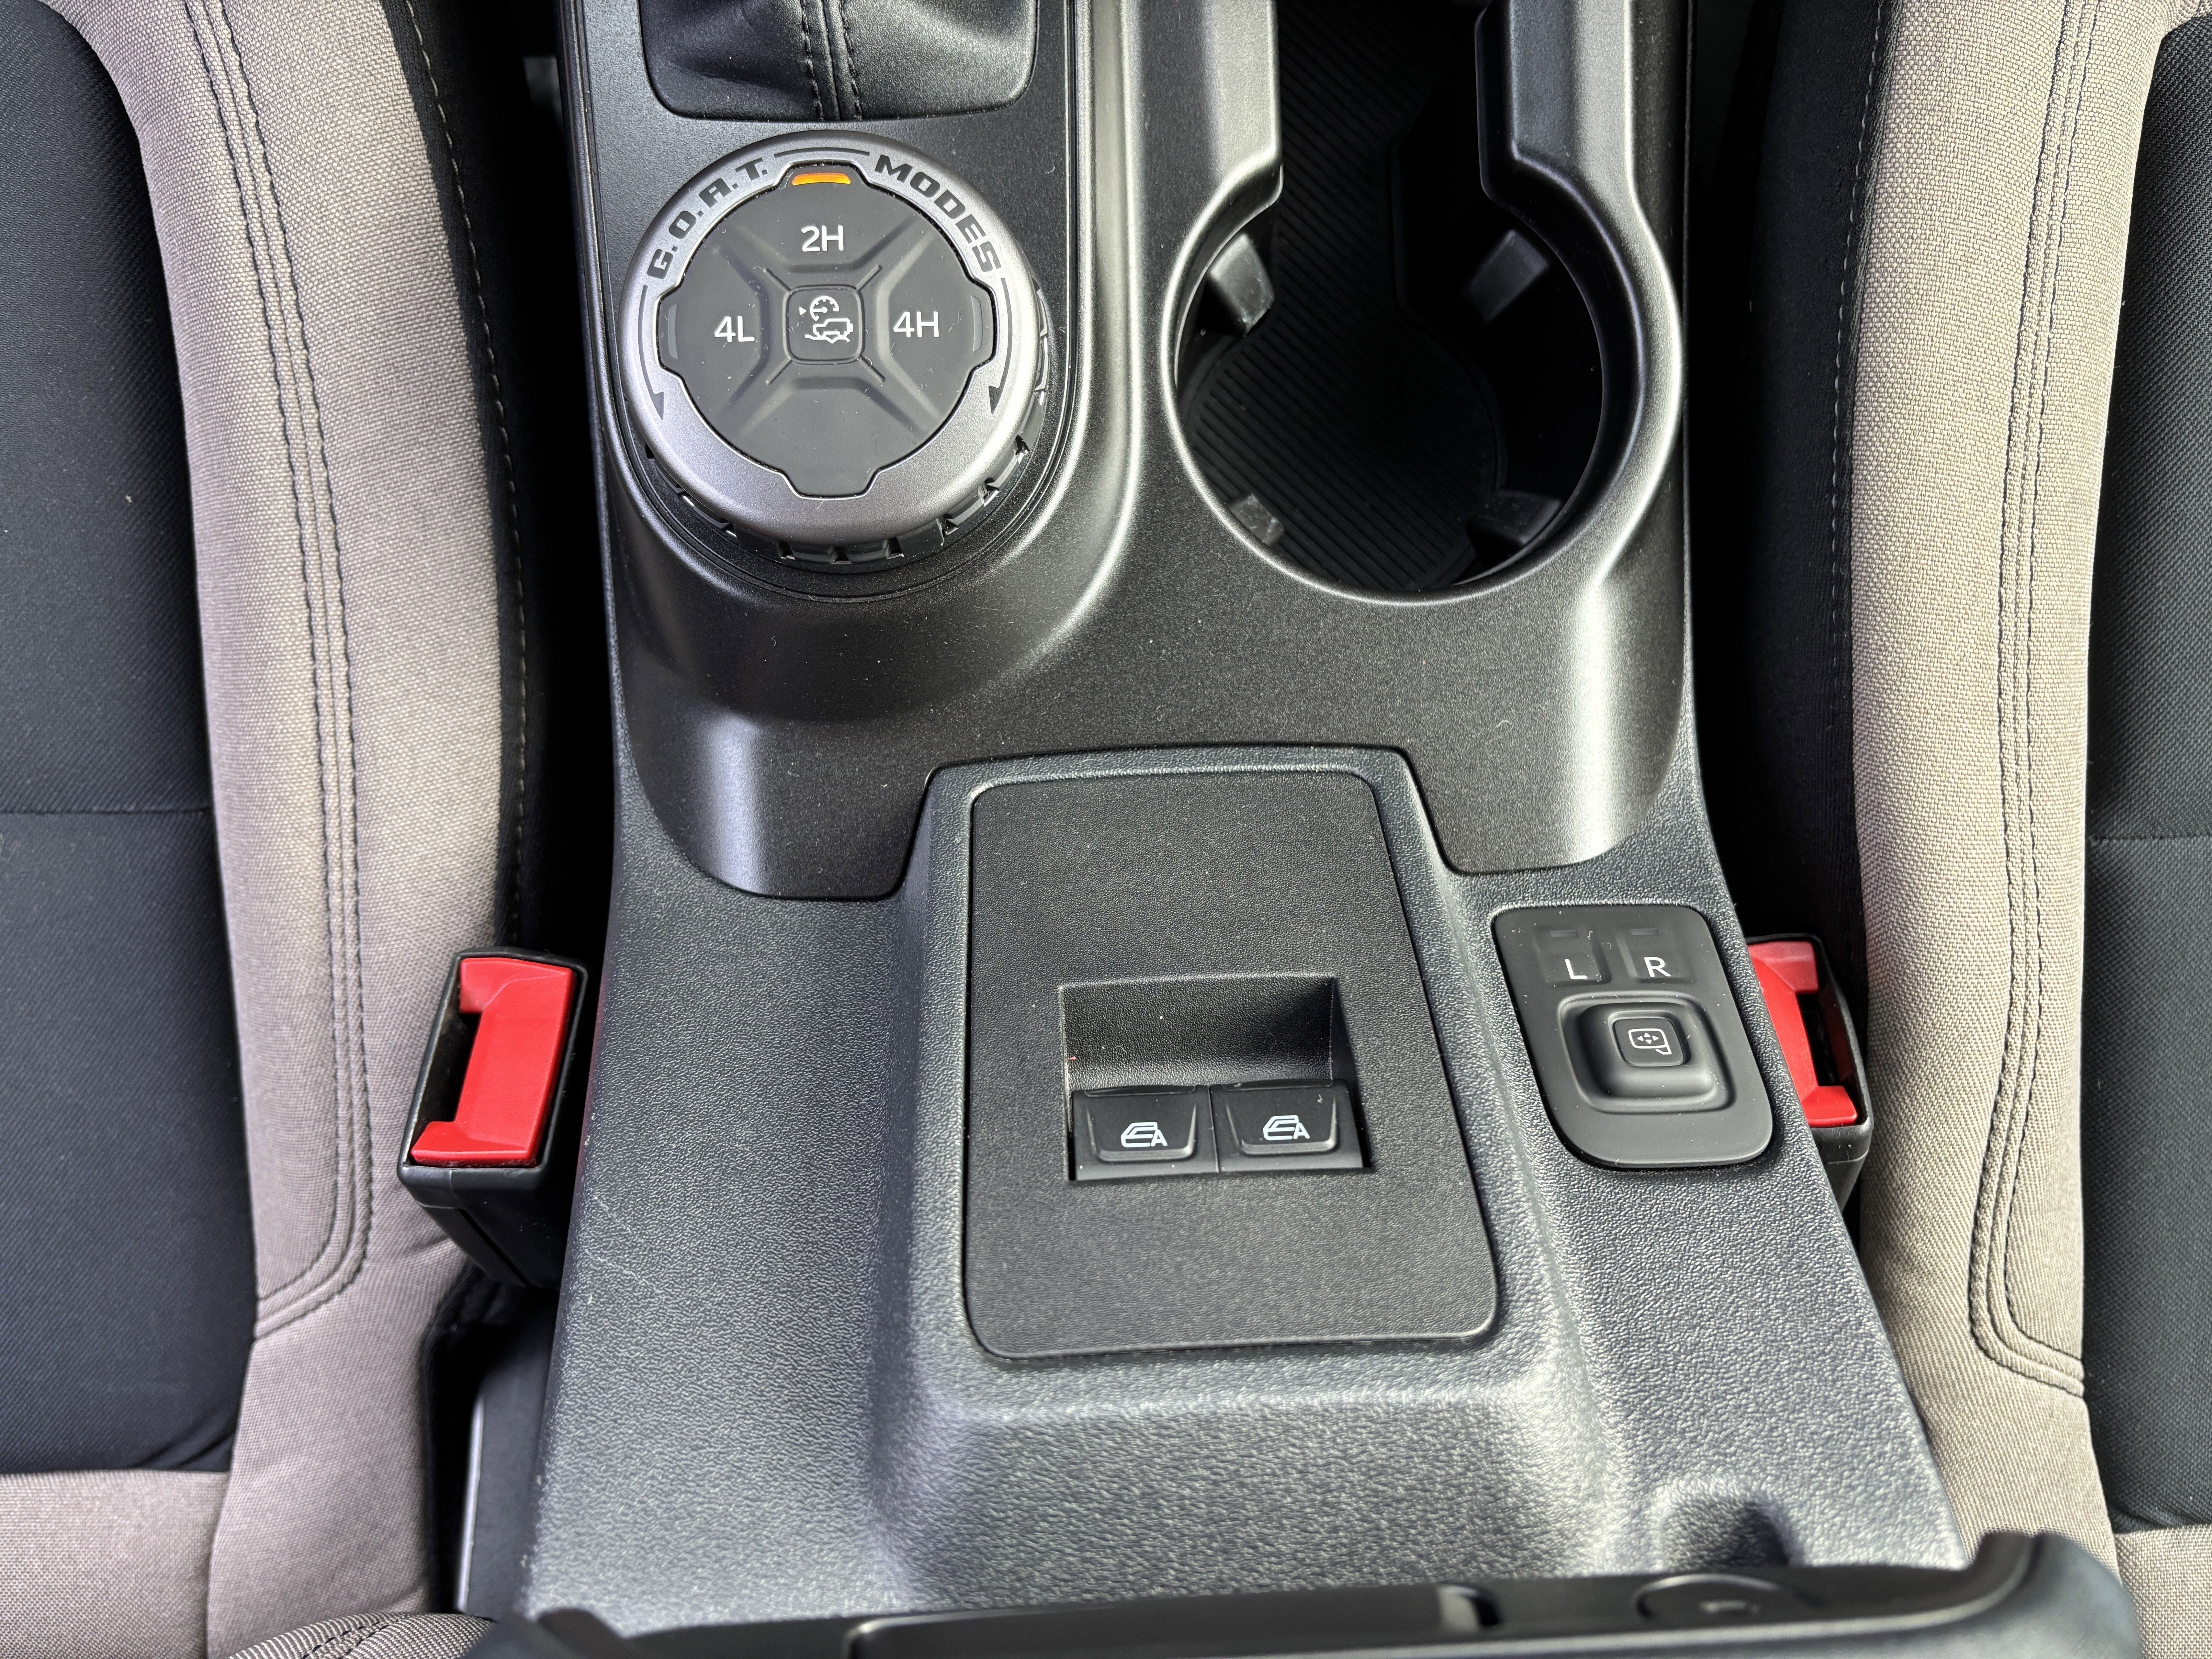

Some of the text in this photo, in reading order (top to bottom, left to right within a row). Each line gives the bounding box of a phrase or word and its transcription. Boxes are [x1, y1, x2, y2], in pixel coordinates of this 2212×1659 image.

[646, 154, 1002, 280] G.O.A.T. MODES
[801, 224, 844, 252] 2H
[714, 315, 755, 343] 4L
[893, 311, 939, 338] 4H
[1565, 958, 1587, 980] L
[1644, 957, 1671, 977] R
